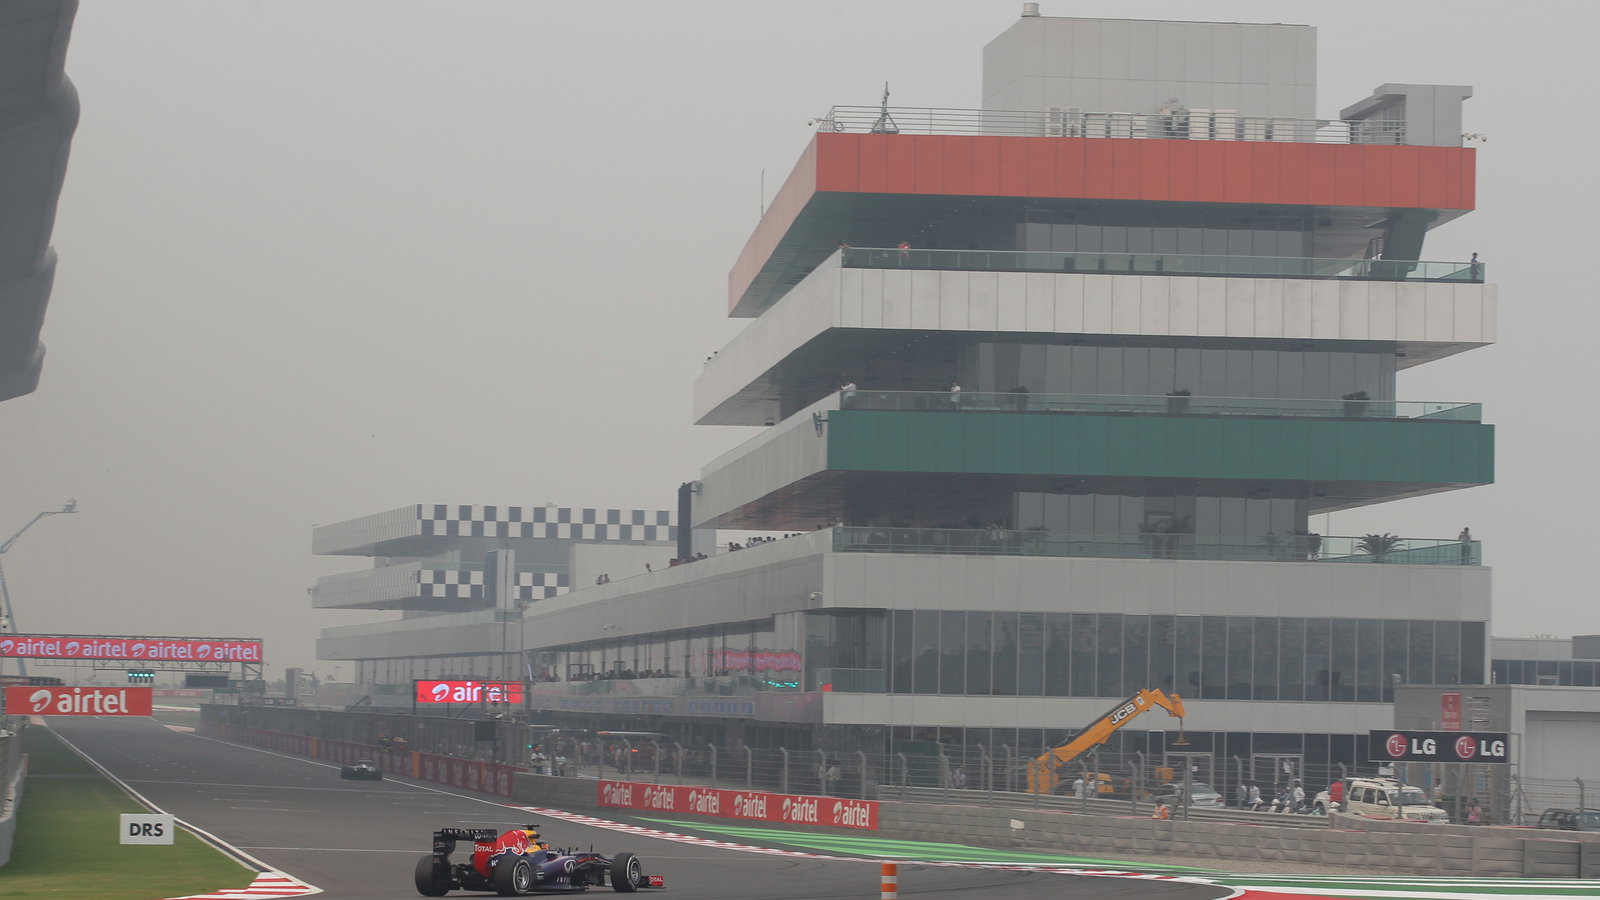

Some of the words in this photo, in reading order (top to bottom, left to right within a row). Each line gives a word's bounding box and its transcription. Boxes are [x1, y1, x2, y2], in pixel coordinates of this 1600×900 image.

[16, 638, 62, 655] airtel
[82, 640, 128, 656] airtel
[148, 642, 193, 659] airtel
[213, 643, 259, 660] airtel
[57, 687, 128, 713] airtel
[1111, 703, 1136, 725] JCB
[1412, 738, 1437, 755] LG
[1480, 740, 1505, 757] LG
[611, 782, 633, 806] airtel
[652, 785, 674, 810] airtel
[696, 788, 720, 814] airtel
[743, 792, 767, 818] airtel
[791, 796, 817, 822] airtel
[843, 800, 869, 827] airtel
[129, 822, 164, 837] DRS
[474, 844, 493, 853] TOTAL
